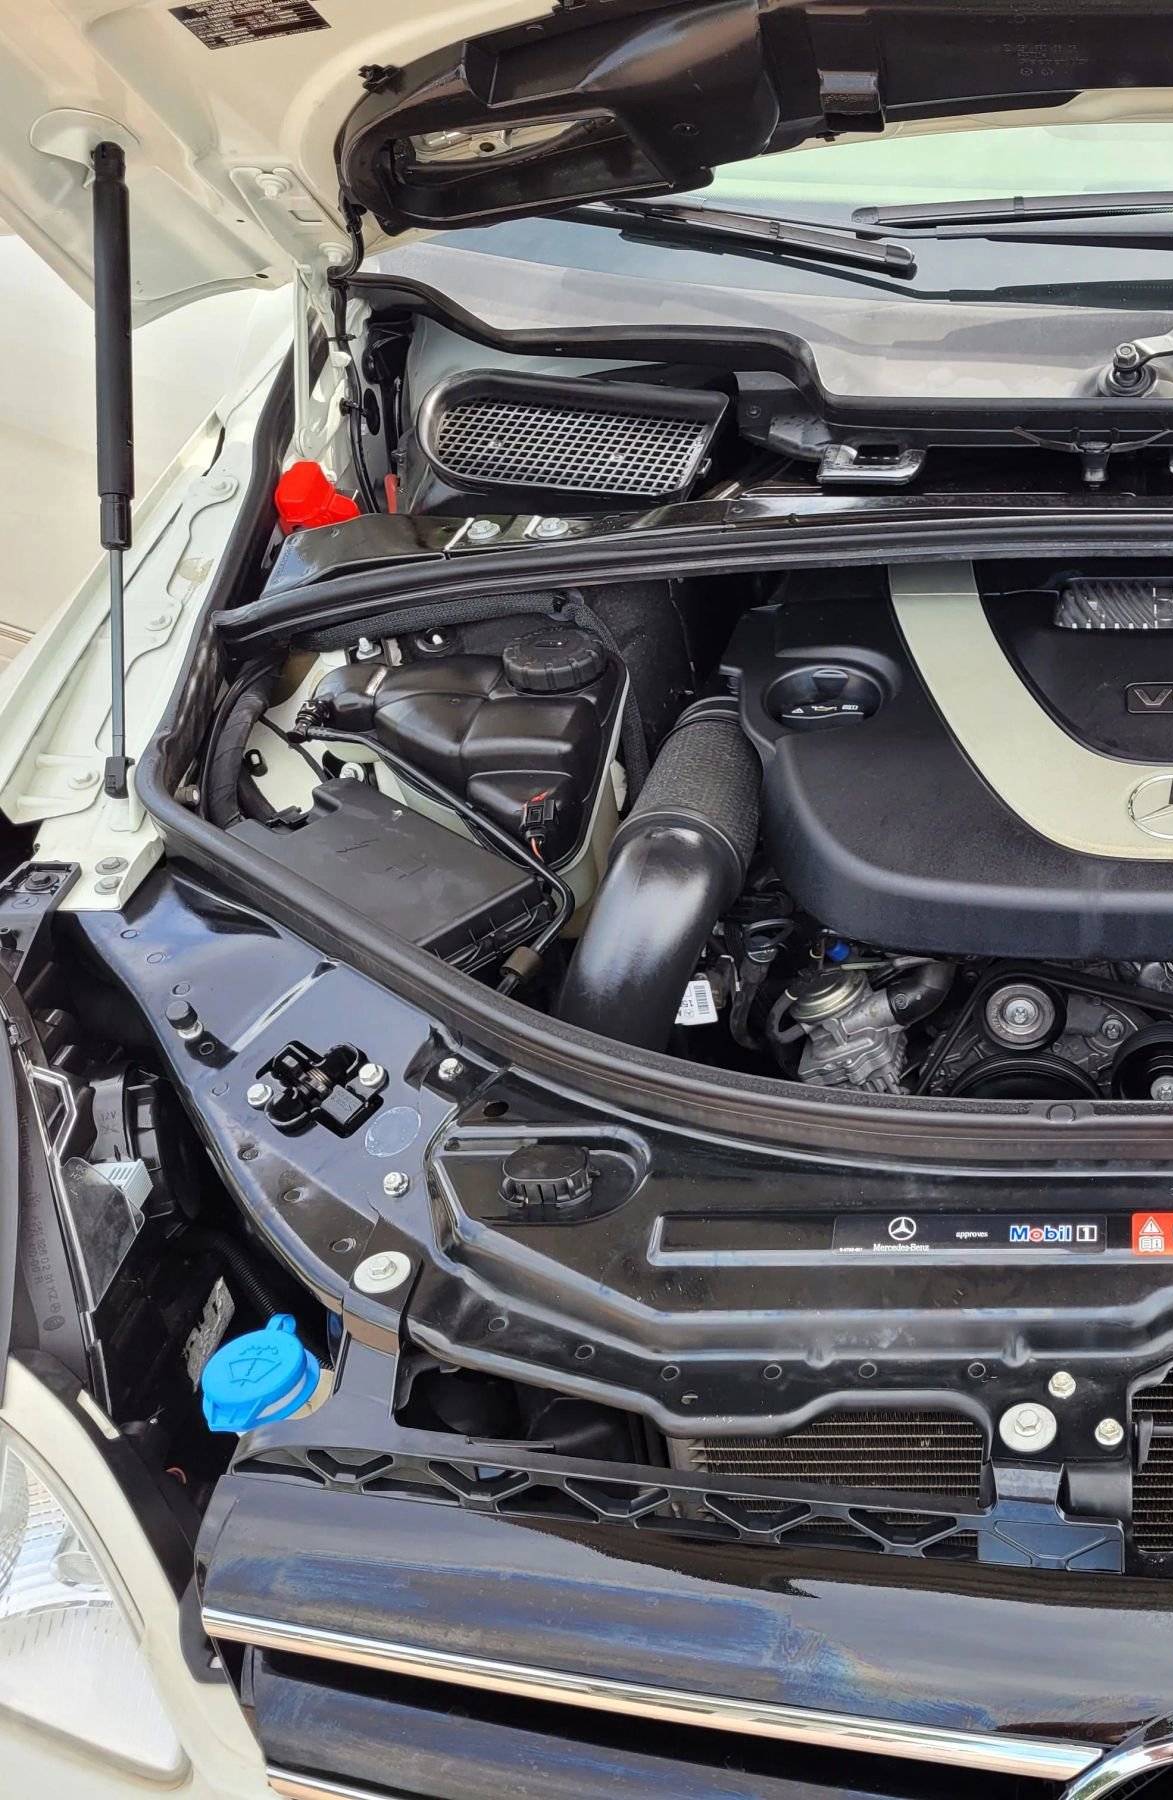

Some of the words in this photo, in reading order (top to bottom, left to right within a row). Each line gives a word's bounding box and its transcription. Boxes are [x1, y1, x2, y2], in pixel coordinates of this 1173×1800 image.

[956, 1231, 988, 1239] approves
[1009, 1225, 1072, 1242] Mobil
[873, 1243, 930, 1252] Mercedes-Benz
